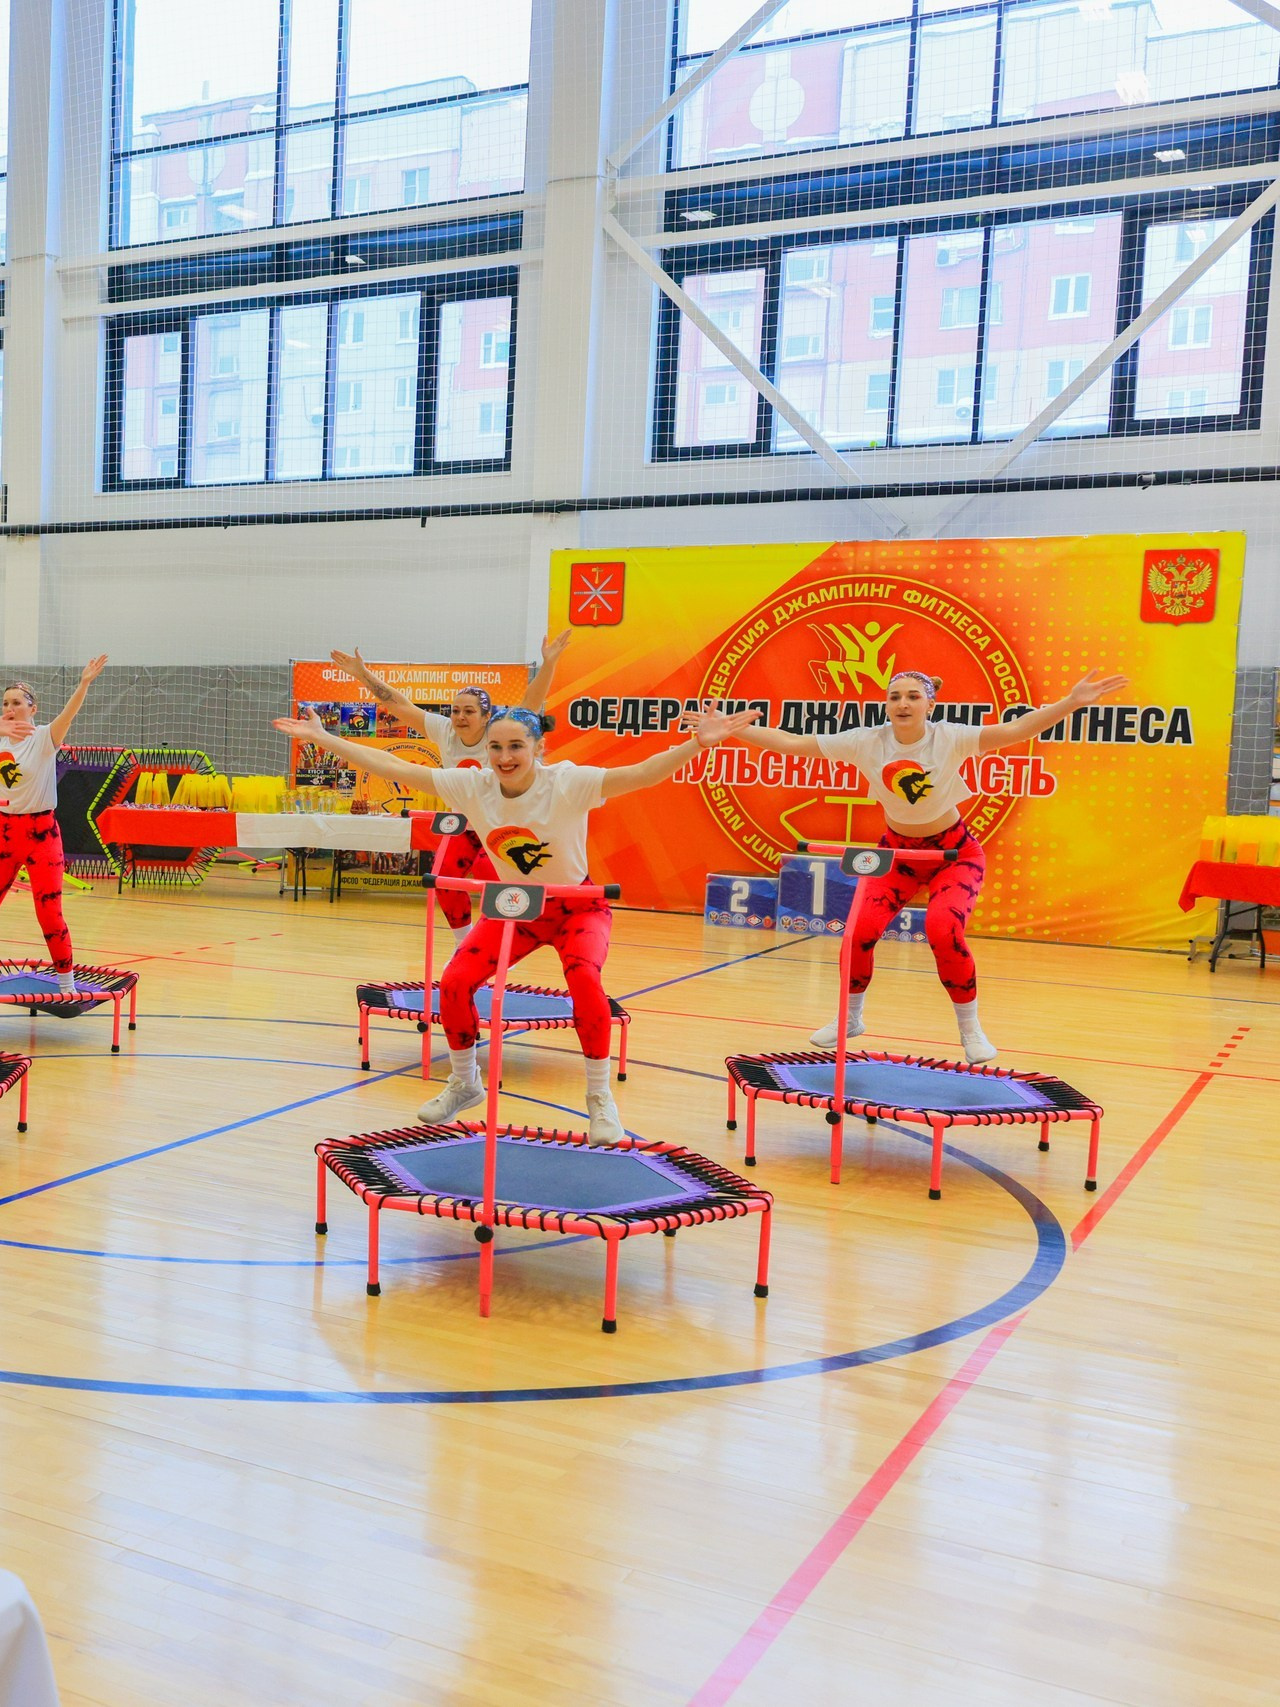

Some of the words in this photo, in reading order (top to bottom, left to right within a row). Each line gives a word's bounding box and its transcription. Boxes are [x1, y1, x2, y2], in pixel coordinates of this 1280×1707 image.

[707, 618, 770, 701] ДЕРАЦИЯ
[772, 583, 897, 626] ДЖАМПИНГ
[902, 589, 992, 652] ФИТНЕСА
[986, 649, 1022, 708] РОСС
[322, 669, 385, 684] ФЕДЕИЯ
[388, 670, 449, 684] ДЖАМПИНГ
[451, 670, 501, 684] ФИТНЕСА
[569, 697, 769, 736] ФЕДЕРАЯ
[780, 700, 993, 736] ДЖАМНГ
[385, 744, 416, 753] ЖАМПИНГ
[671, 746, 860, 790] УЛЬСКАЯ
[401, 879, 422, 888] ДЖАМ
[730, 880, 750, 913] 2
[809, 862, 825, 915] 1
[900, 911, 912, 931] 3
